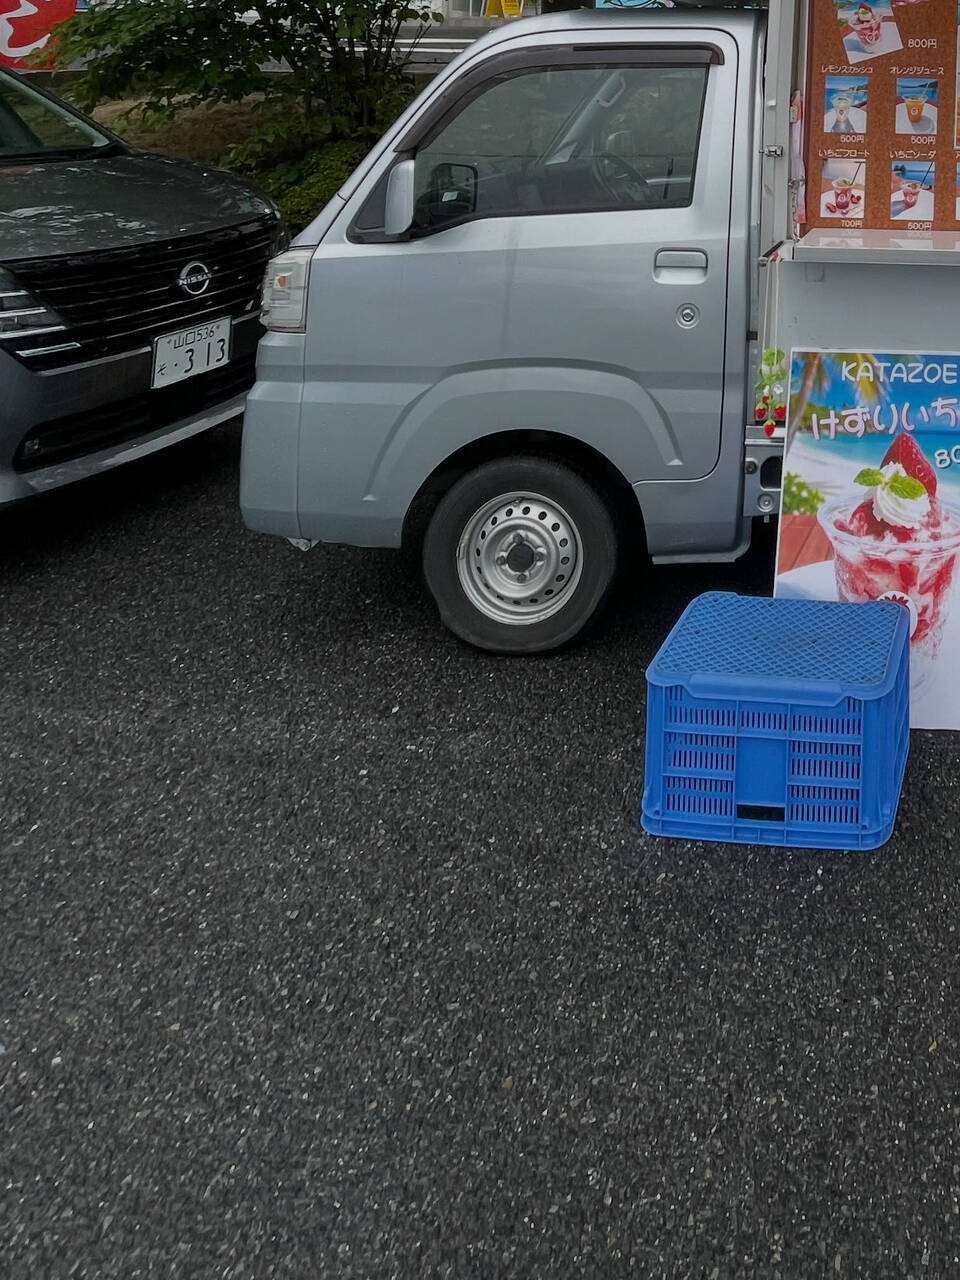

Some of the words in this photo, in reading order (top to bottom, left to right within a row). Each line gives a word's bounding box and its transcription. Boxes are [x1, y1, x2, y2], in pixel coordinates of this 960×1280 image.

[908, 38, 937, 49] 800円
[889, 66, 945, 76] オレンジジュース
[818, 148, 870, 158] いちごフロート
[889, 150, 937, 159] いちごソーダ
[841, 361, 958, 385] KATAZOE
